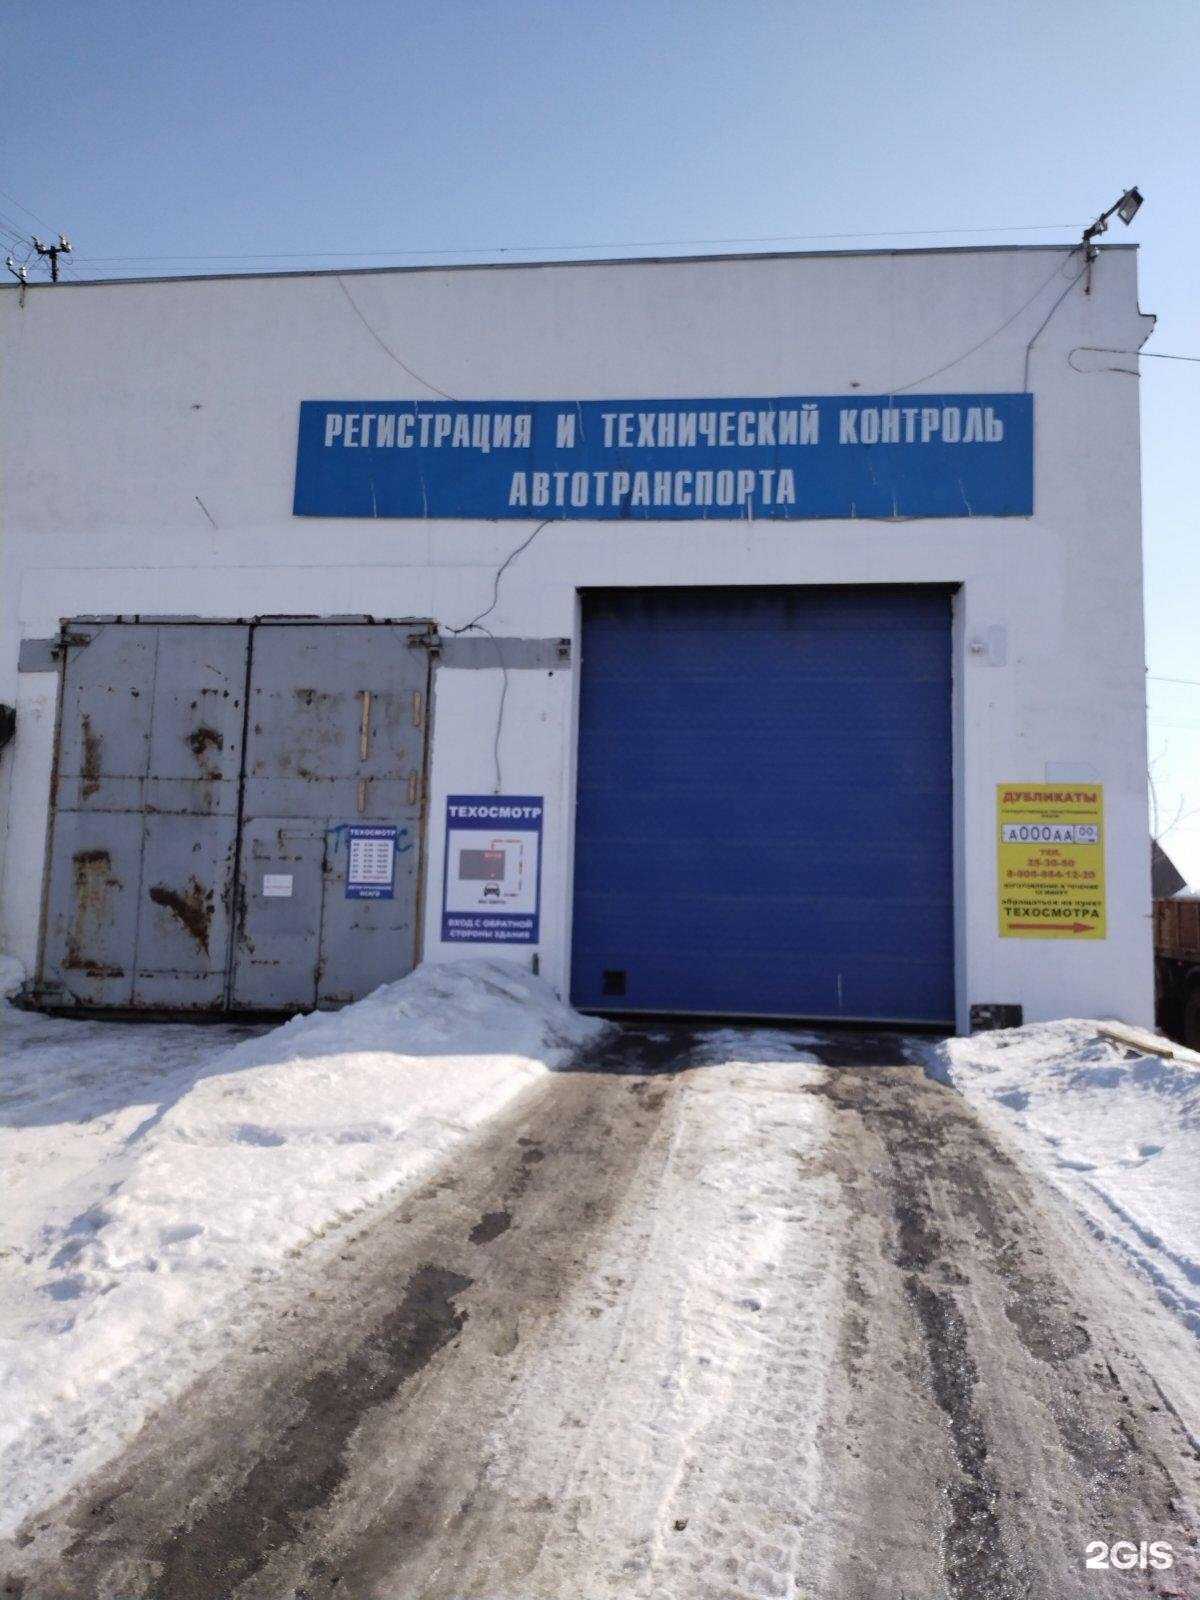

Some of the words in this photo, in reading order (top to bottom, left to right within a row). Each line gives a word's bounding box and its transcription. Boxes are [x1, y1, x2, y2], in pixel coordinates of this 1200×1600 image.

[324, 413, 532, 454] РЕГИСТРАЦИЯ
[556, 414, 576, 448] И
[601, 403, 820, 448] ТЕХНИЧЕСКИЙ
[839, 407, 1004, 445] КОНТРОЛЬ
[508, 469, 796, 507] АВТОТРАНСПОРТА
[1003, 791, 1098, 804] ДУБЛИКАТЫ
[449, 806, 542, 818] ТЕХОСМОТР
[1004, 907, 1100, 918] ТЕХОСМОТРА
[448, 918, 473, 928] ВХОД
[482, 918, 533, 928] ОБРАТНОЙ
[449, 929, 493, 938] СТОРОНЫ
